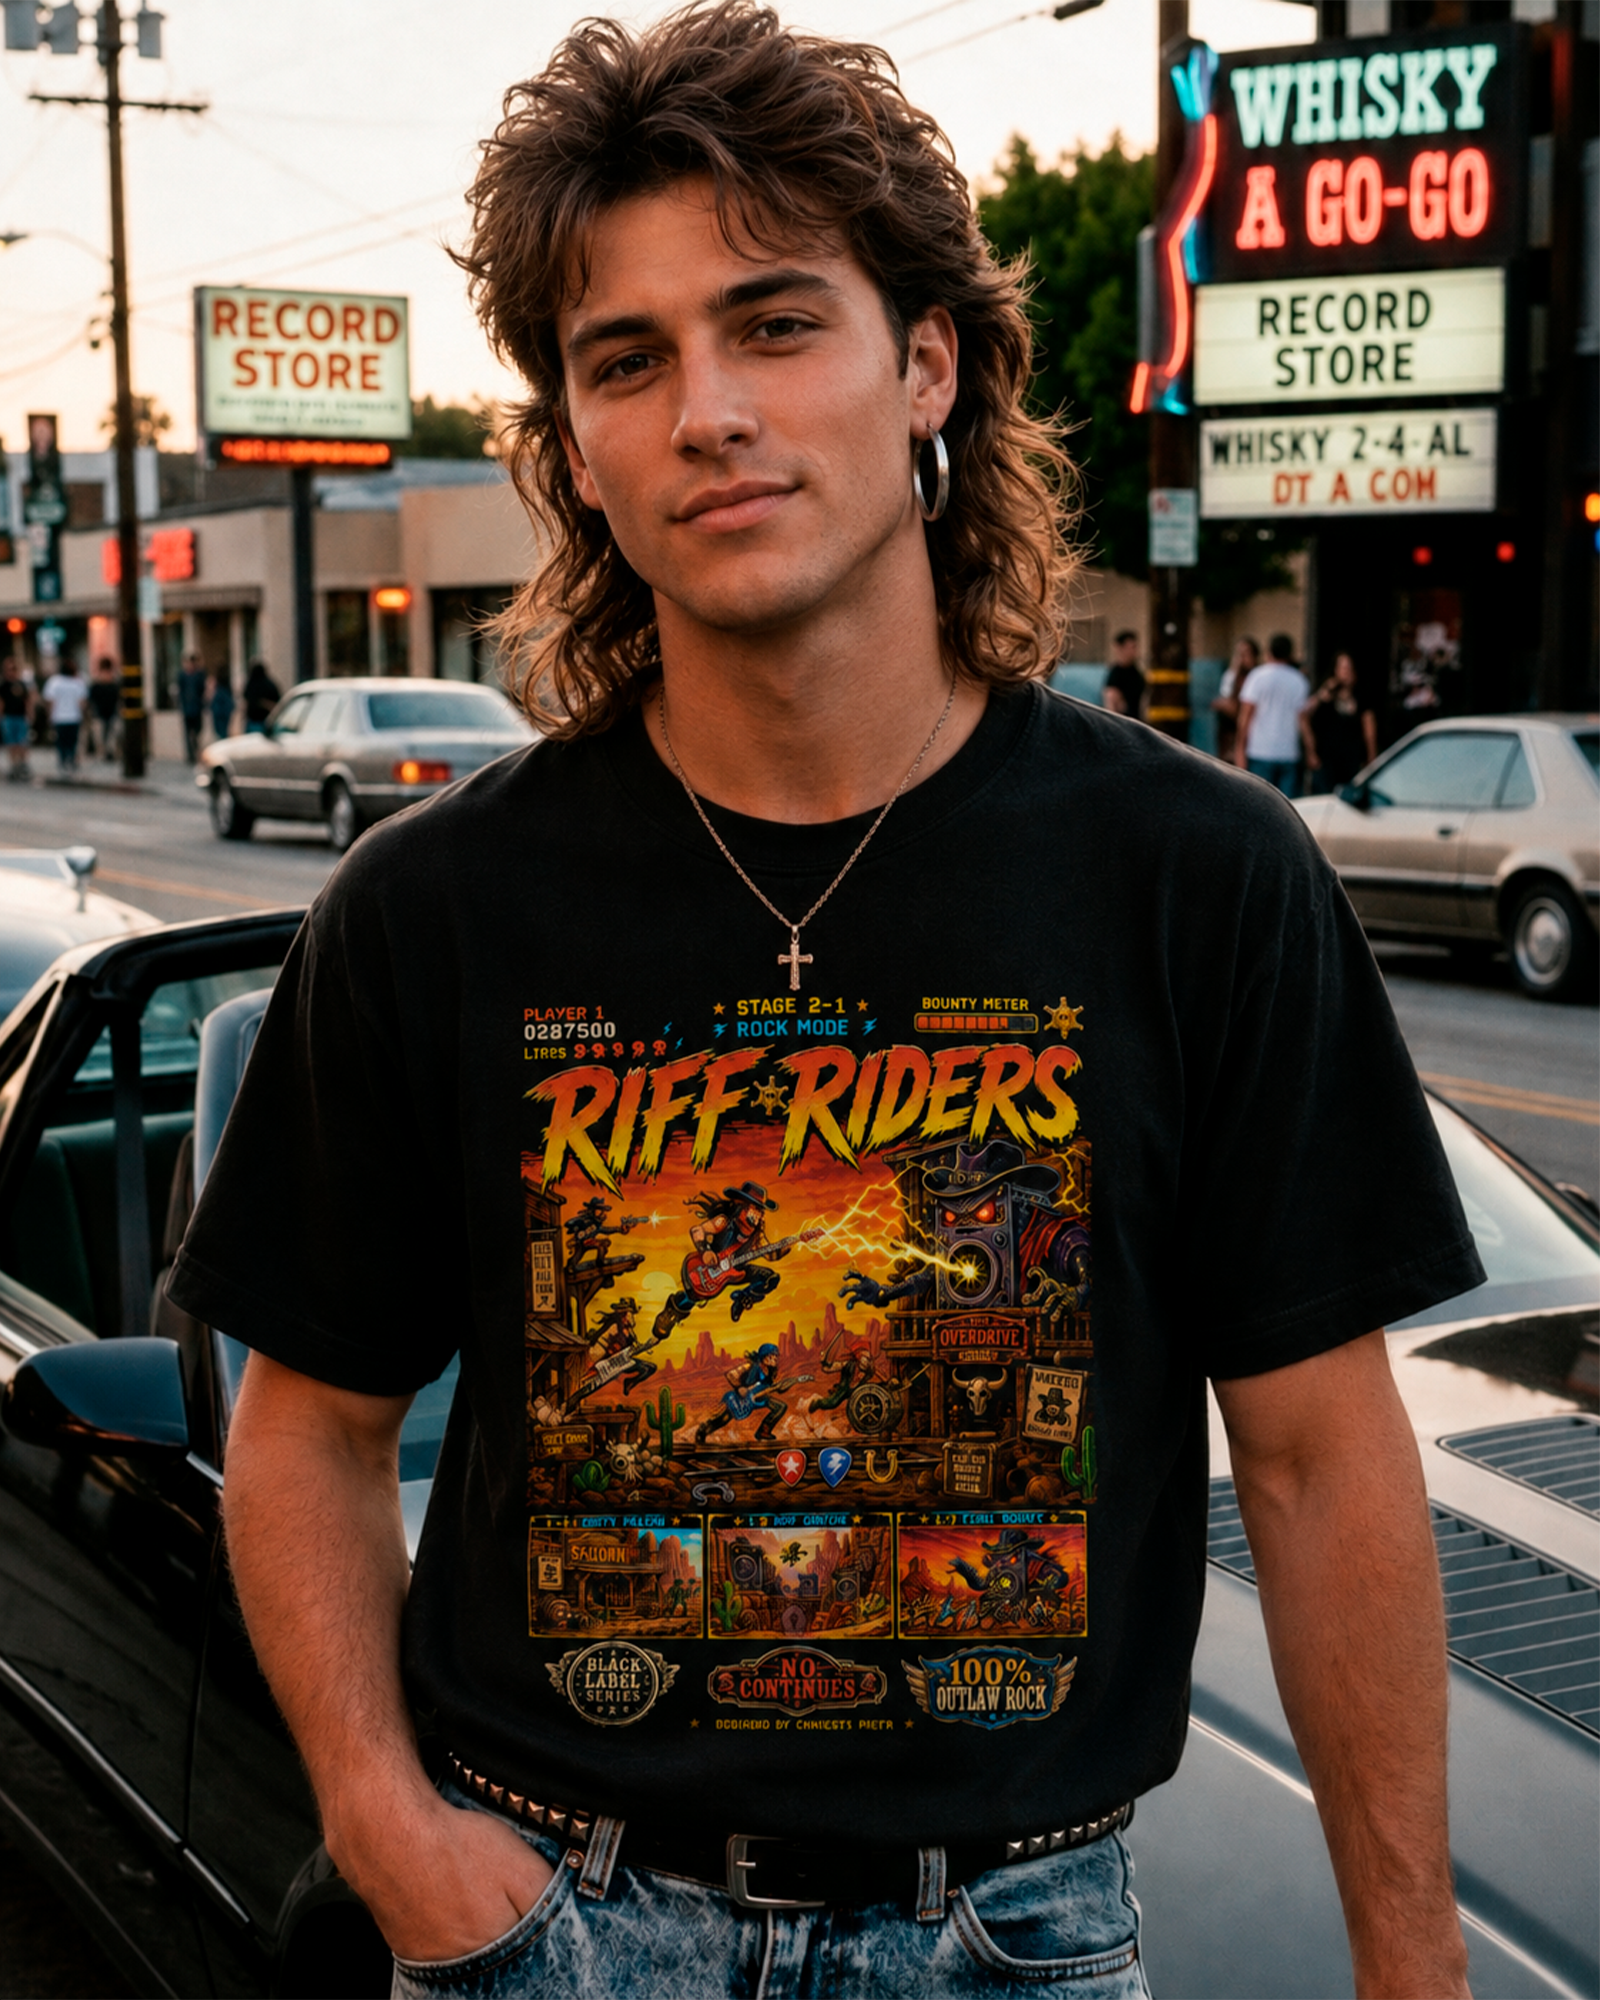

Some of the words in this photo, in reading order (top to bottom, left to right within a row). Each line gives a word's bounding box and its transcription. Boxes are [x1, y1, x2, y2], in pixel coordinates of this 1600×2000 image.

[1230, 44, 1497, 148] WHISKY
[1236, 165, 1285, 249] A
[1306, 148, 1489, 246] GO-GO
[213, 298, 400, 344] RECORD
[1259, 289, 1431, 336] RECORD
[234, 348, 380, 391] STORE
[1276, 342, 1413, 387] STORE
[1209, 428, 1331, 465] WHISKY
[1331, 472, 1350, 503] A
[524, 1006, 587, 1021] PLAYER
[595, 1005, 604, 1020] 1
[737, 997, 797, 1015] STAGE
[808, 997, 846, 1014] 2-1
[922, 997, 977, 1010] BOUNTY
[983, 998, 1029, 1011] METER
[524, 1021, 616, 1040] 0287500
[737, 1020, 789, 1038] ROCK
[797, 1019, 849, 1036] MODE
[522, 1044, 774, 1200] RIFF
[774, 1043, 1083, 1175] RIDERS
[940, 1329, 1019, 1346] OVERDRIVE
[587, 1658, 641, 1672] BLACK
[950, 1657, 1032, 1686] 100%
[585, 1672, 640, 1689] LABEL
[739, 1678, 856, 1699] CONTINUES
[586, 1690, 640, 1702] SERIES
[936, 1686, 1000, 1711] OUTLAW
[1005, 1685, 1047, 1710] ROCK
